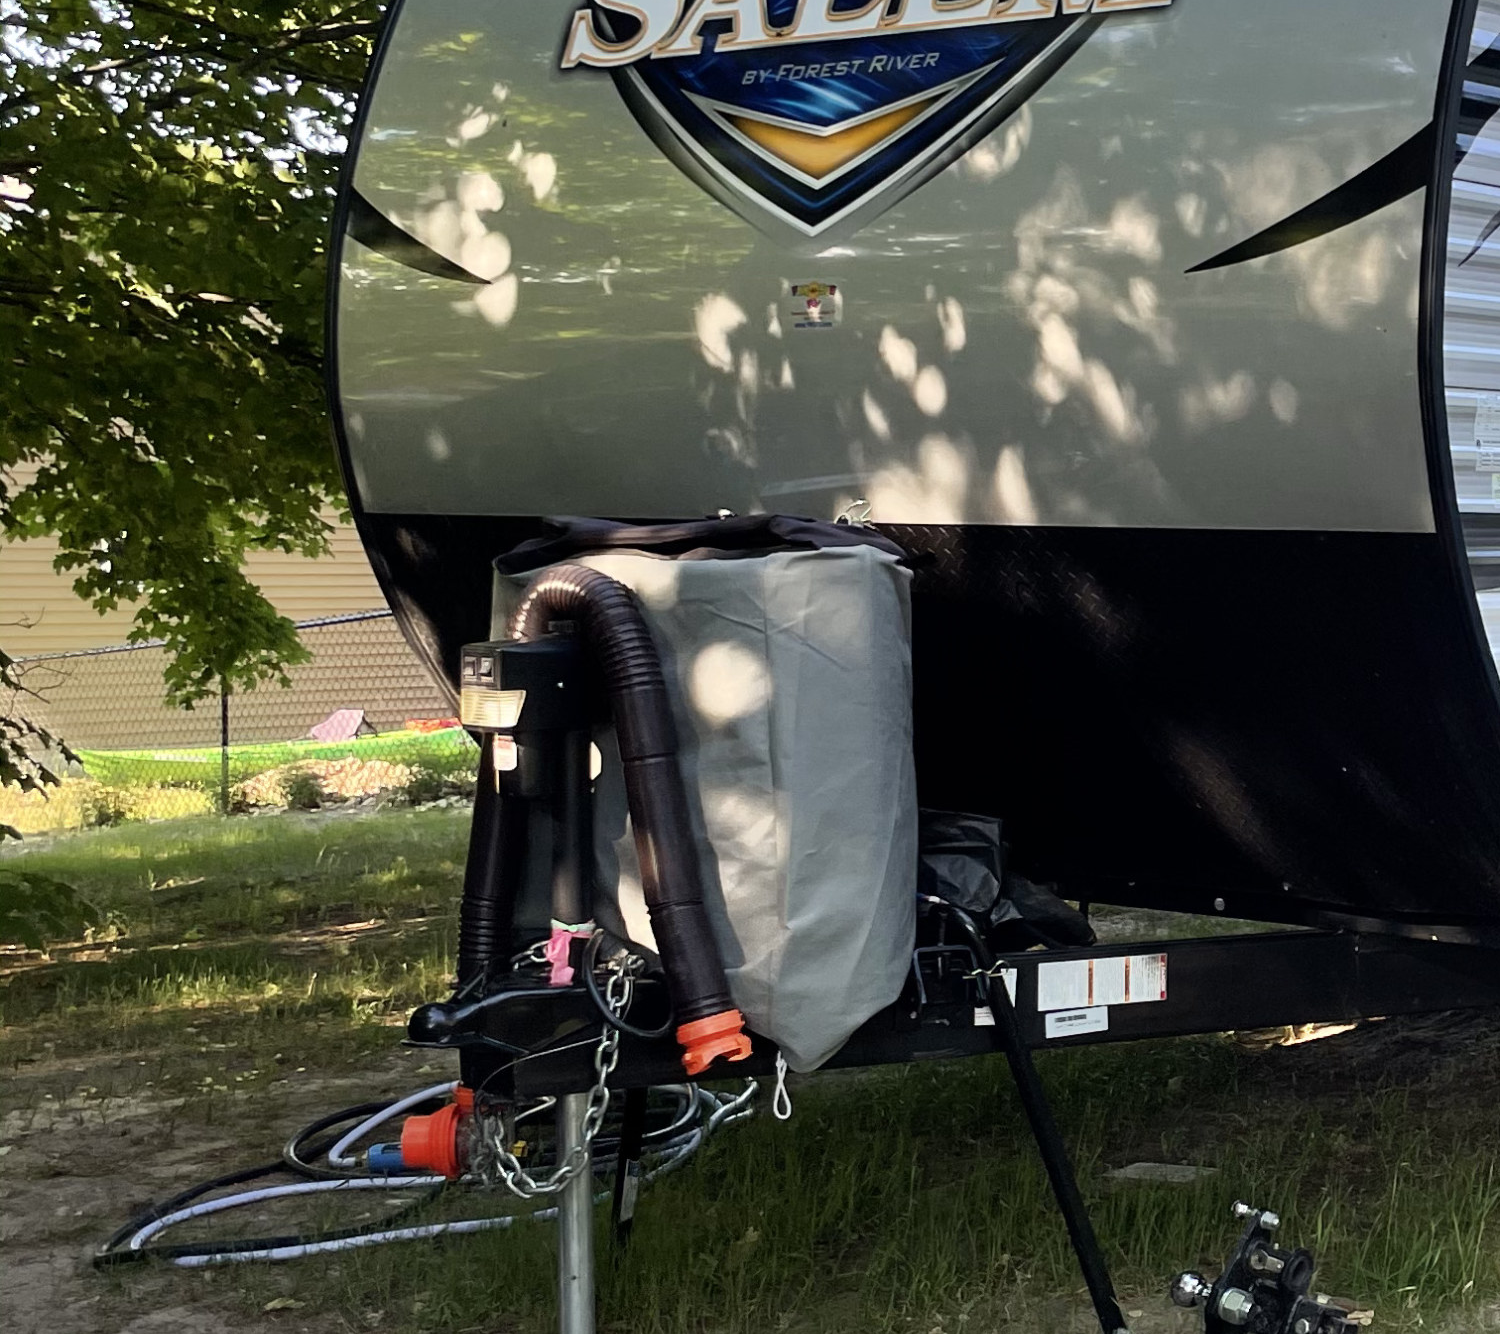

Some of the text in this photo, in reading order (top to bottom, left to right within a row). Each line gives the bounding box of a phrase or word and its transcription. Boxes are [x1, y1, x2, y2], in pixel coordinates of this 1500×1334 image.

[741, 52, 940, 85] BY FOREST RIVER
